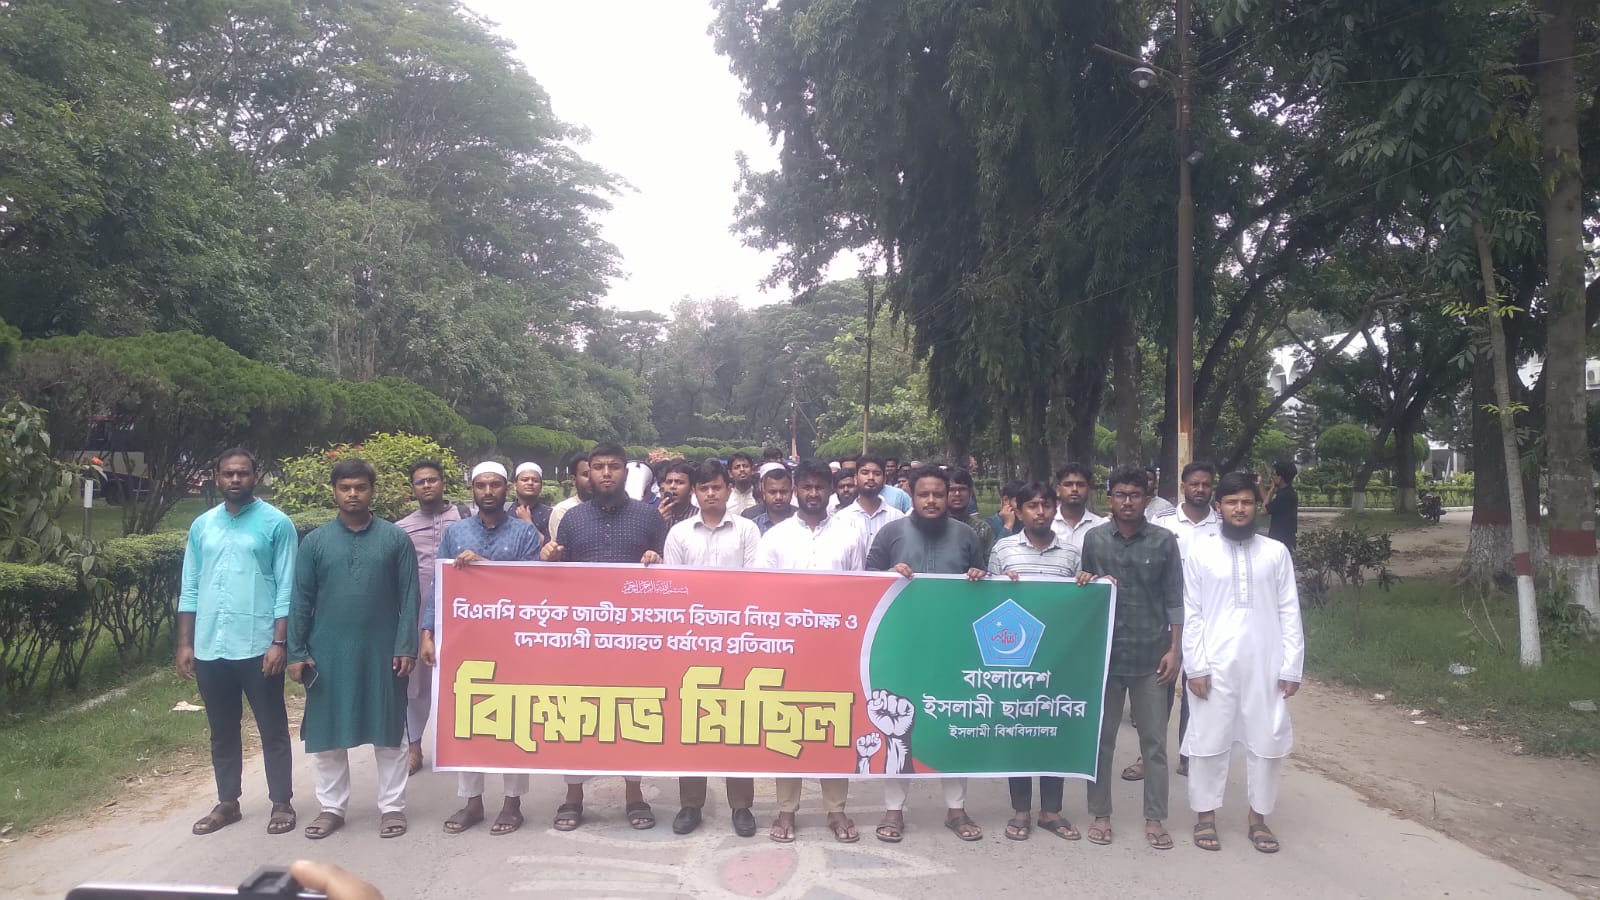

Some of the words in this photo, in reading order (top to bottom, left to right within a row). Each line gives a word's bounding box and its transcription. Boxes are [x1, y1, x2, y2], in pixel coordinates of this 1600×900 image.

[453, 598, 516, 621] বিএনপি
[519, 600, 568, 627] কর্তৃক
[572, 601, 628, 625] জাতীয়
[631, 606, 686, 626] সংসদে
[689, 604, 742, 627] হিজাব
[744, 606, 781, 630] নিয়ে
[784, 609, 842, 630] কটাক্ষ
[845, 614, 859, 630] ও
[514, 628, 591, 650] দেশব্যাপী
[595, 634, 663, 651] অব্যাহত
[667, 630, 723, 654] ধর্ষণের
[727, 632, 795, 655] প্রতিবাদে
[961, 668, 1051, 689] বাংলাদেশ
[453, 660, 667, 752] বিক্ষোভ
[679, 665, 855, 759] মিছিল
[922, 694, 995, 720] ইসলামী
[1001, 694, 1088, 719] ছাত্রশিবির
[948, 723, 991, 739] ইসলামী
